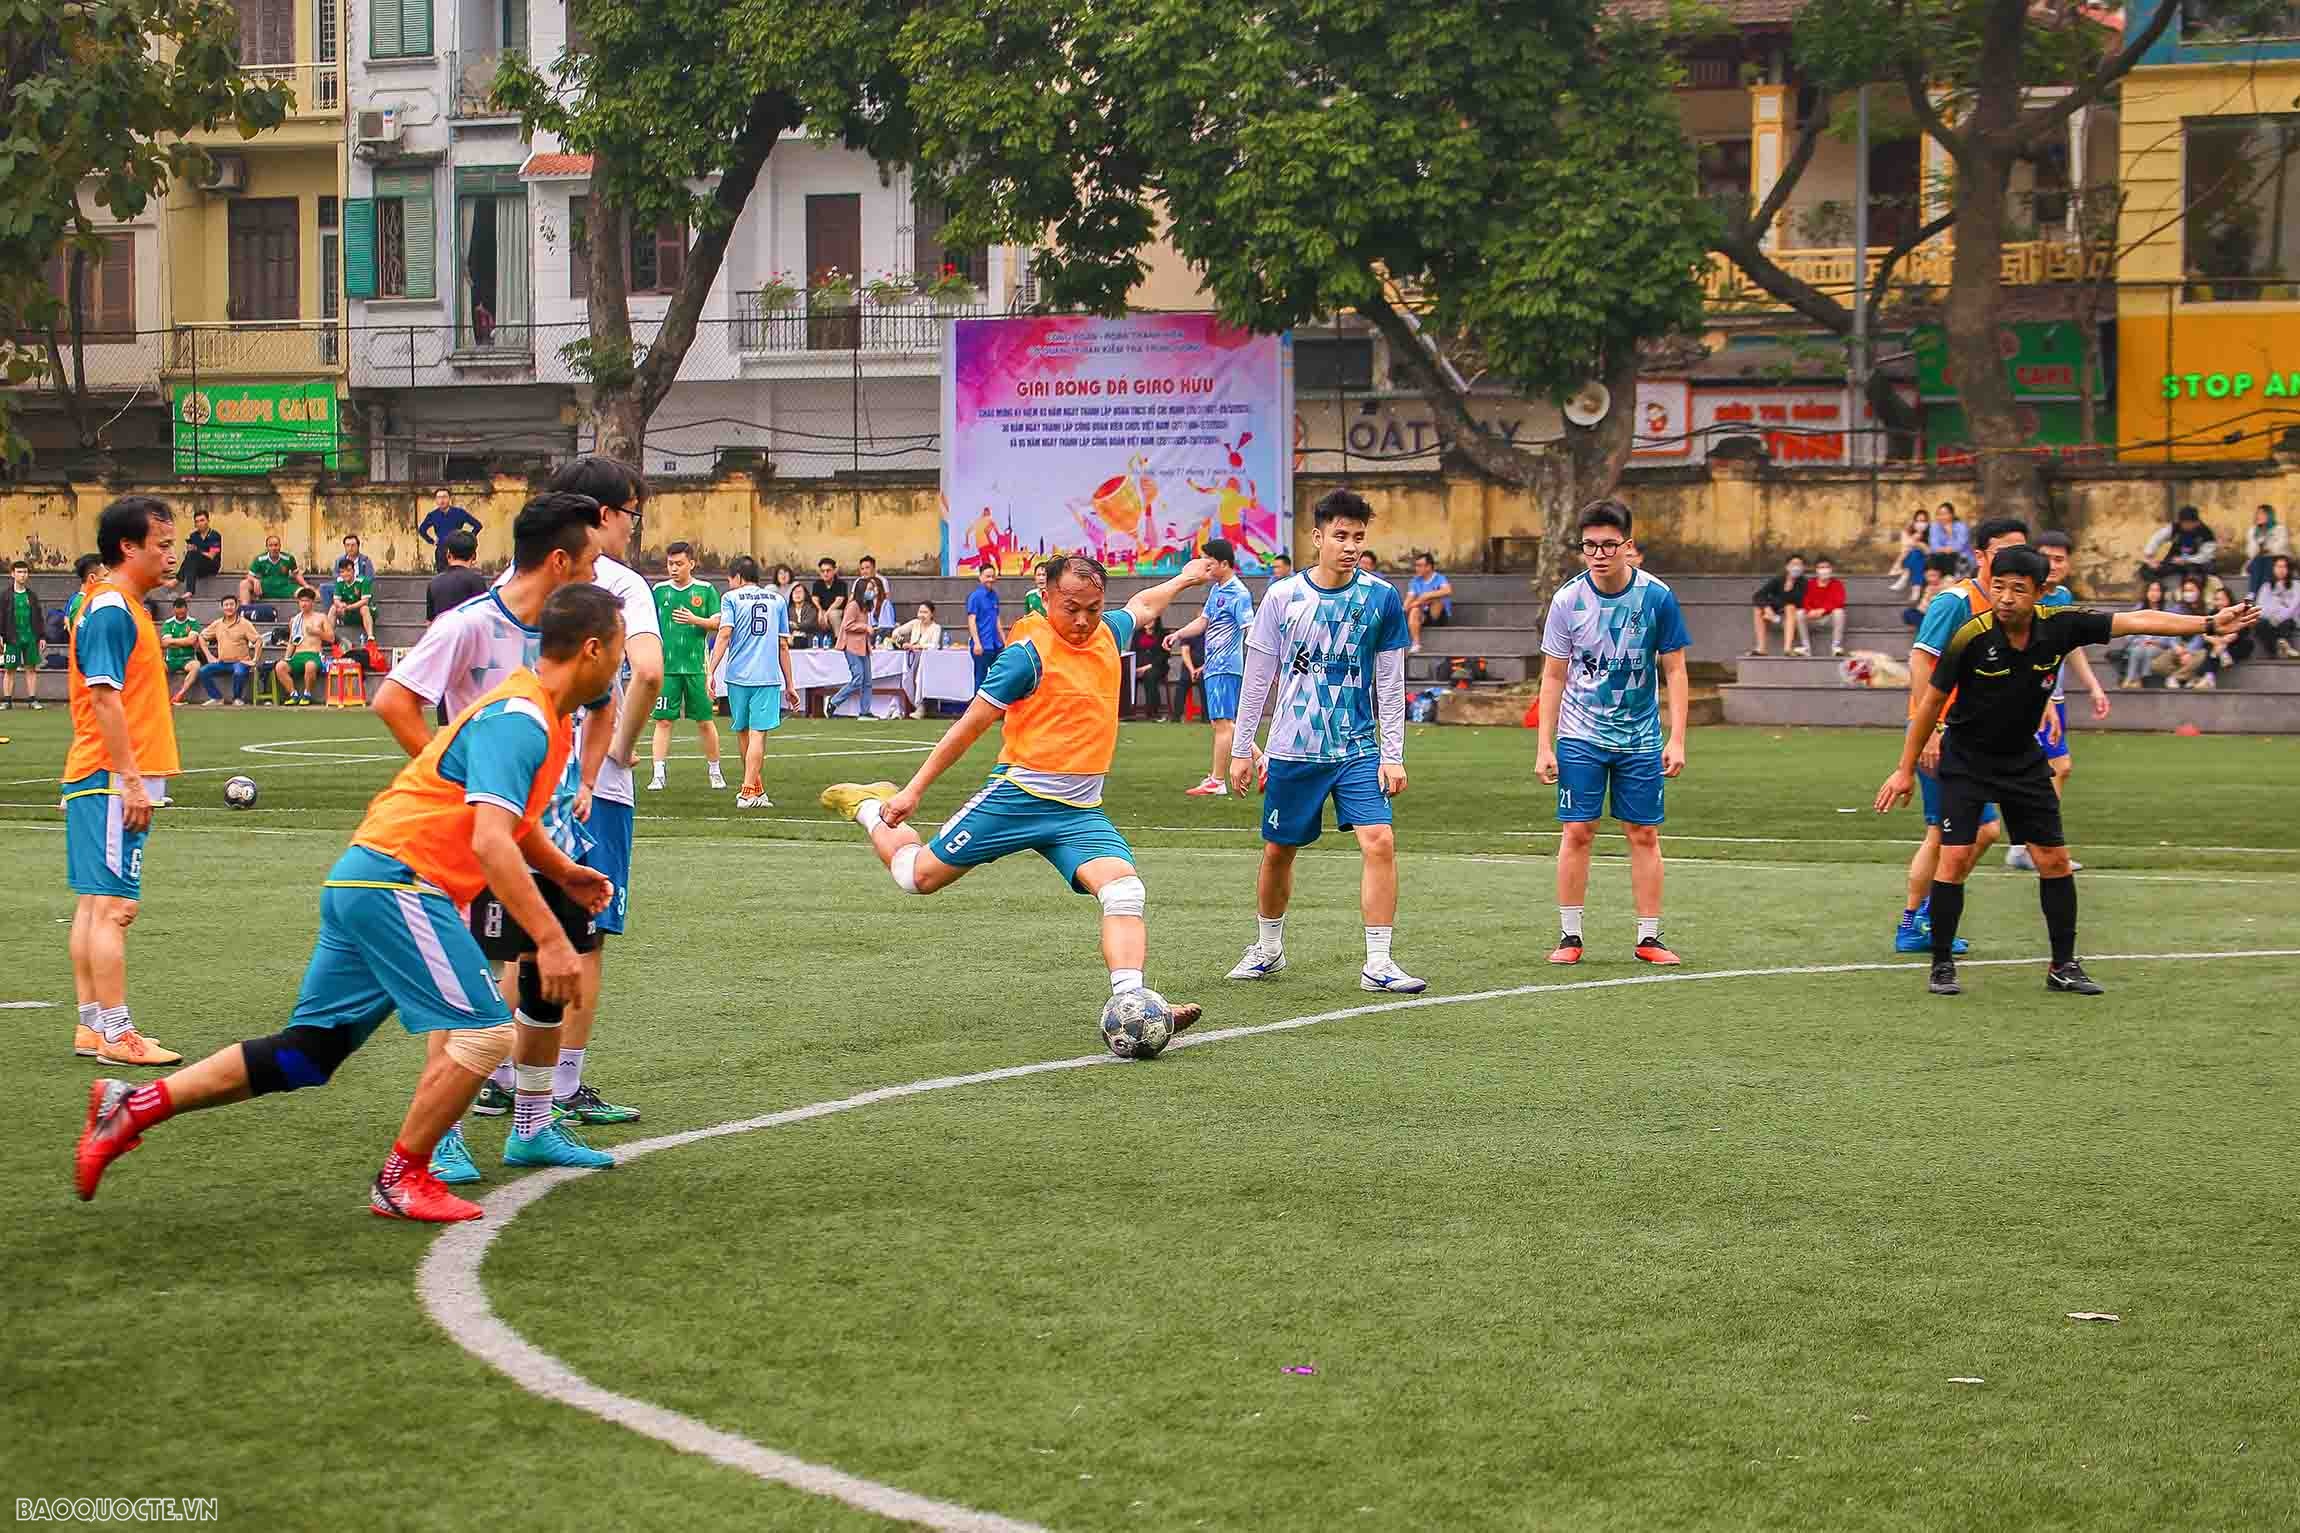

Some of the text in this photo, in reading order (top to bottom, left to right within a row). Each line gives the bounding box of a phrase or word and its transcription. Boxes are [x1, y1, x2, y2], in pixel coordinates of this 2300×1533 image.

[1134, 378, 1175, 395] GIAO
[2161, 371, 2253, 400] STOP
[751, 603, 768, 636] 6
[1560, 788, 1571, 809] 21
[1268, 808, 1280, 830] 4
[945, 830, 972, 854] 9
